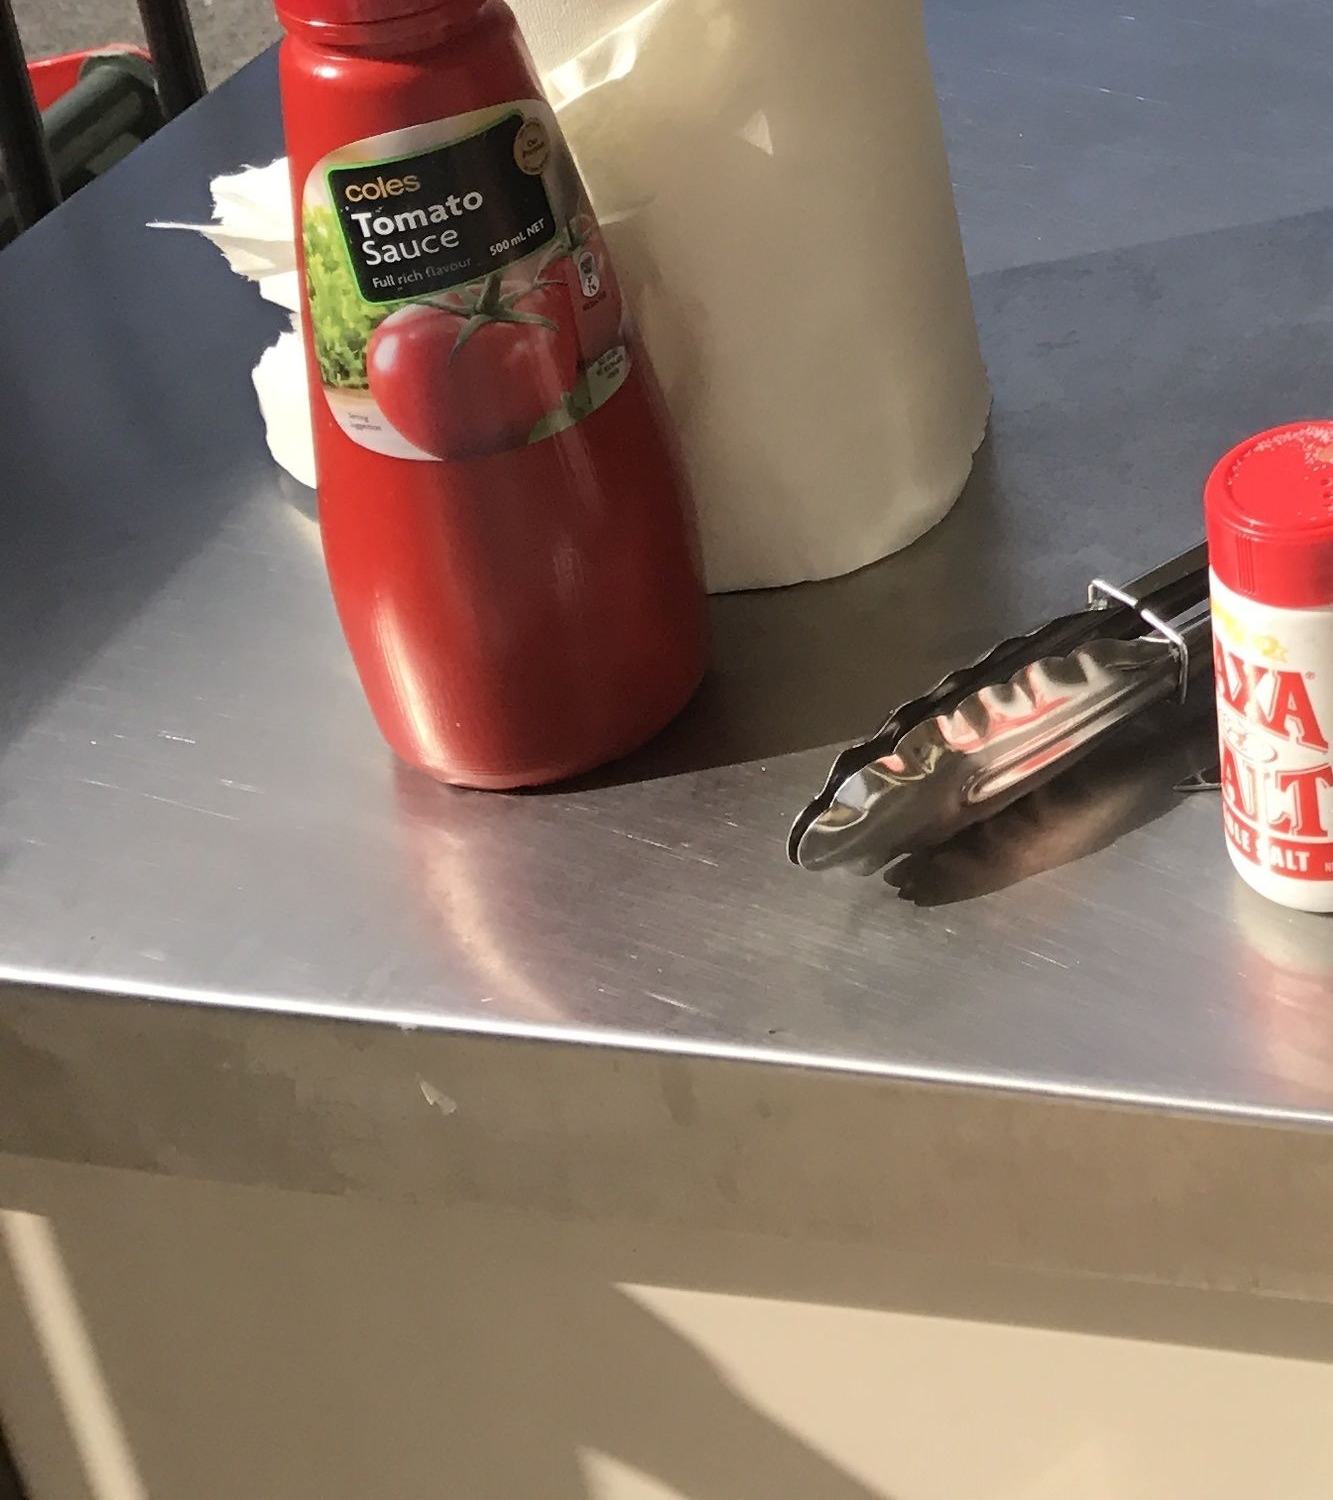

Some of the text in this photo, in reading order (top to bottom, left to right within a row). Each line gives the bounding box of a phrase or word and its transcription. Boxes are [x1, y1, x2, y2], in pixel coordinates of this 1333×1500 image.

[345, 175, 421, 202] coles
[351, 191, 483, 238] Tomato
[361, 229, 460, 266] Sauce
[489, 218, 546, 257] 500 mL NET
[372, 257, 472, 289] Full rich flavour
[1213, 633, 1329, 754] AXA
